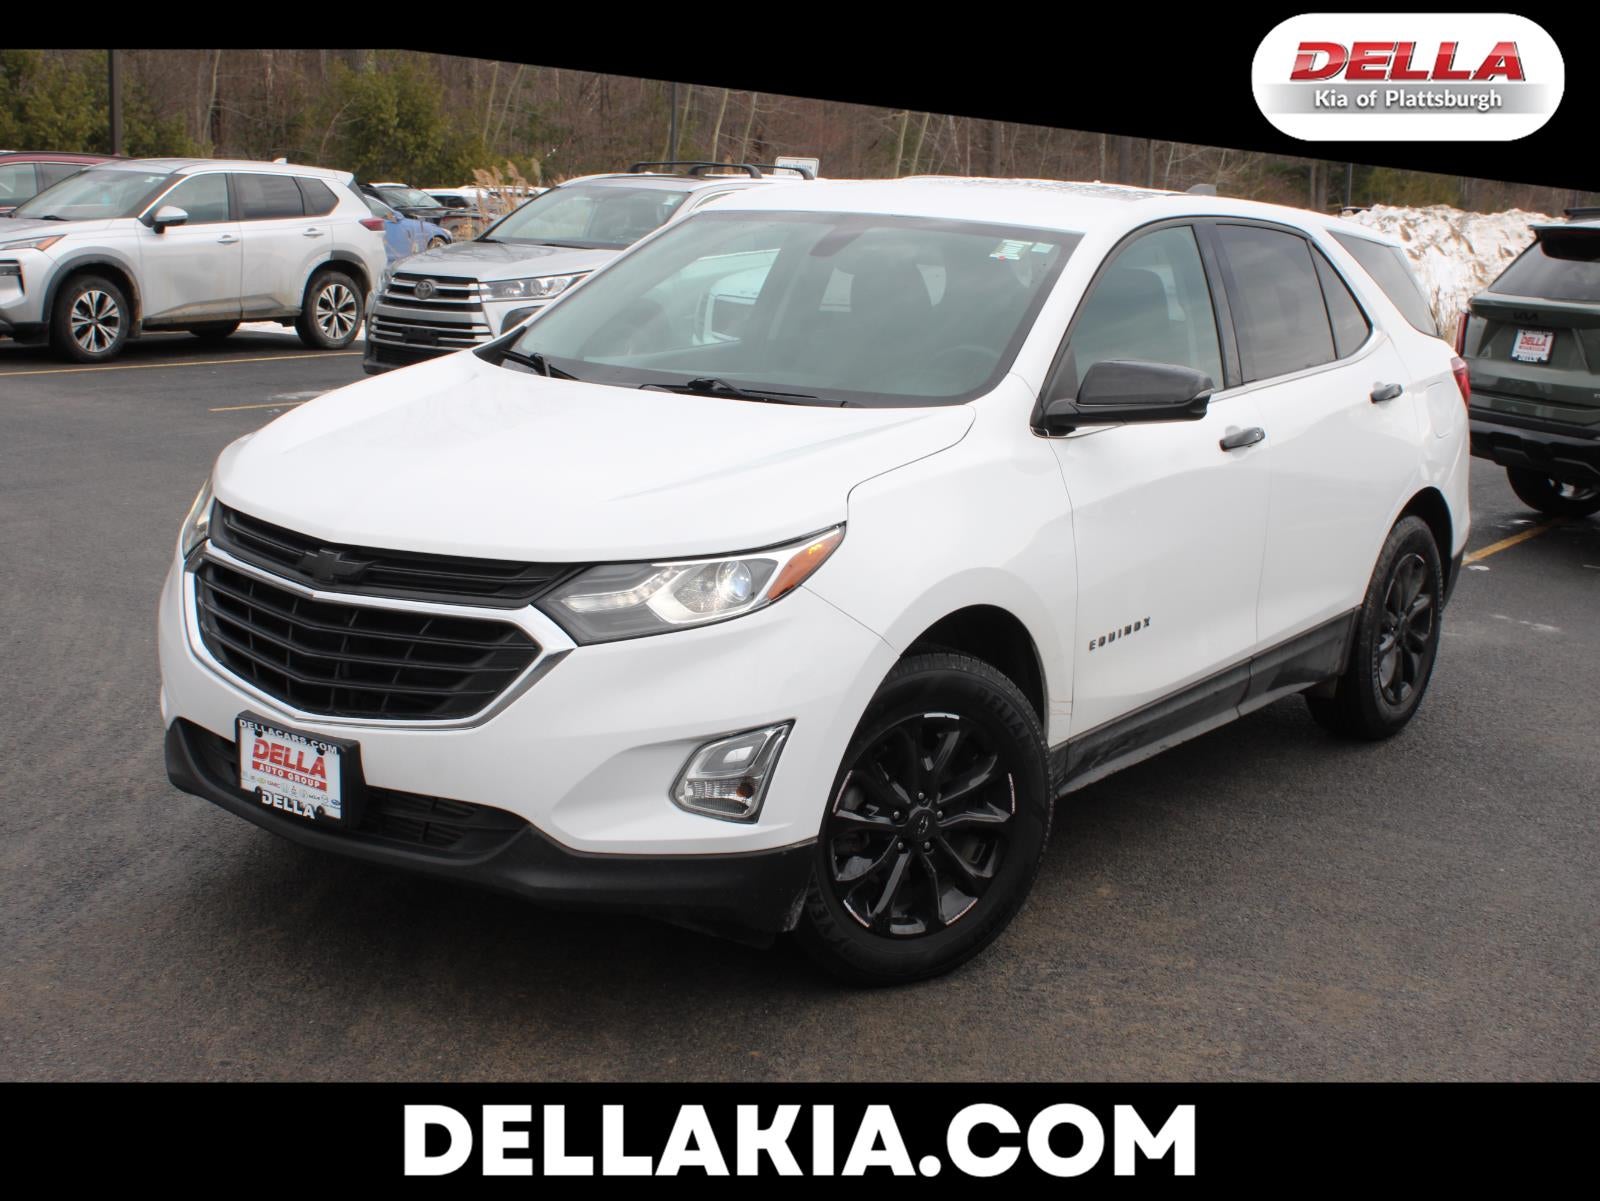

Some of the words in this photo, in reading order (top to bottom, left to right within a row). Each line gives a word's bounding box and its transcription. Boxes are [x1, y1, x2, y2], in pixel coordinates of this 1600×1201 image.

[1088, 616, 1151, 651] EQUINOX
[239, 719, 338, 754] DELLACARS.COM
[252, 738, 327, 779] DELLA
[259, 765, 284, 777] AUTO
[287, 772, 321, 788] GROUP
[261, 790, 316, 819] DELLA
